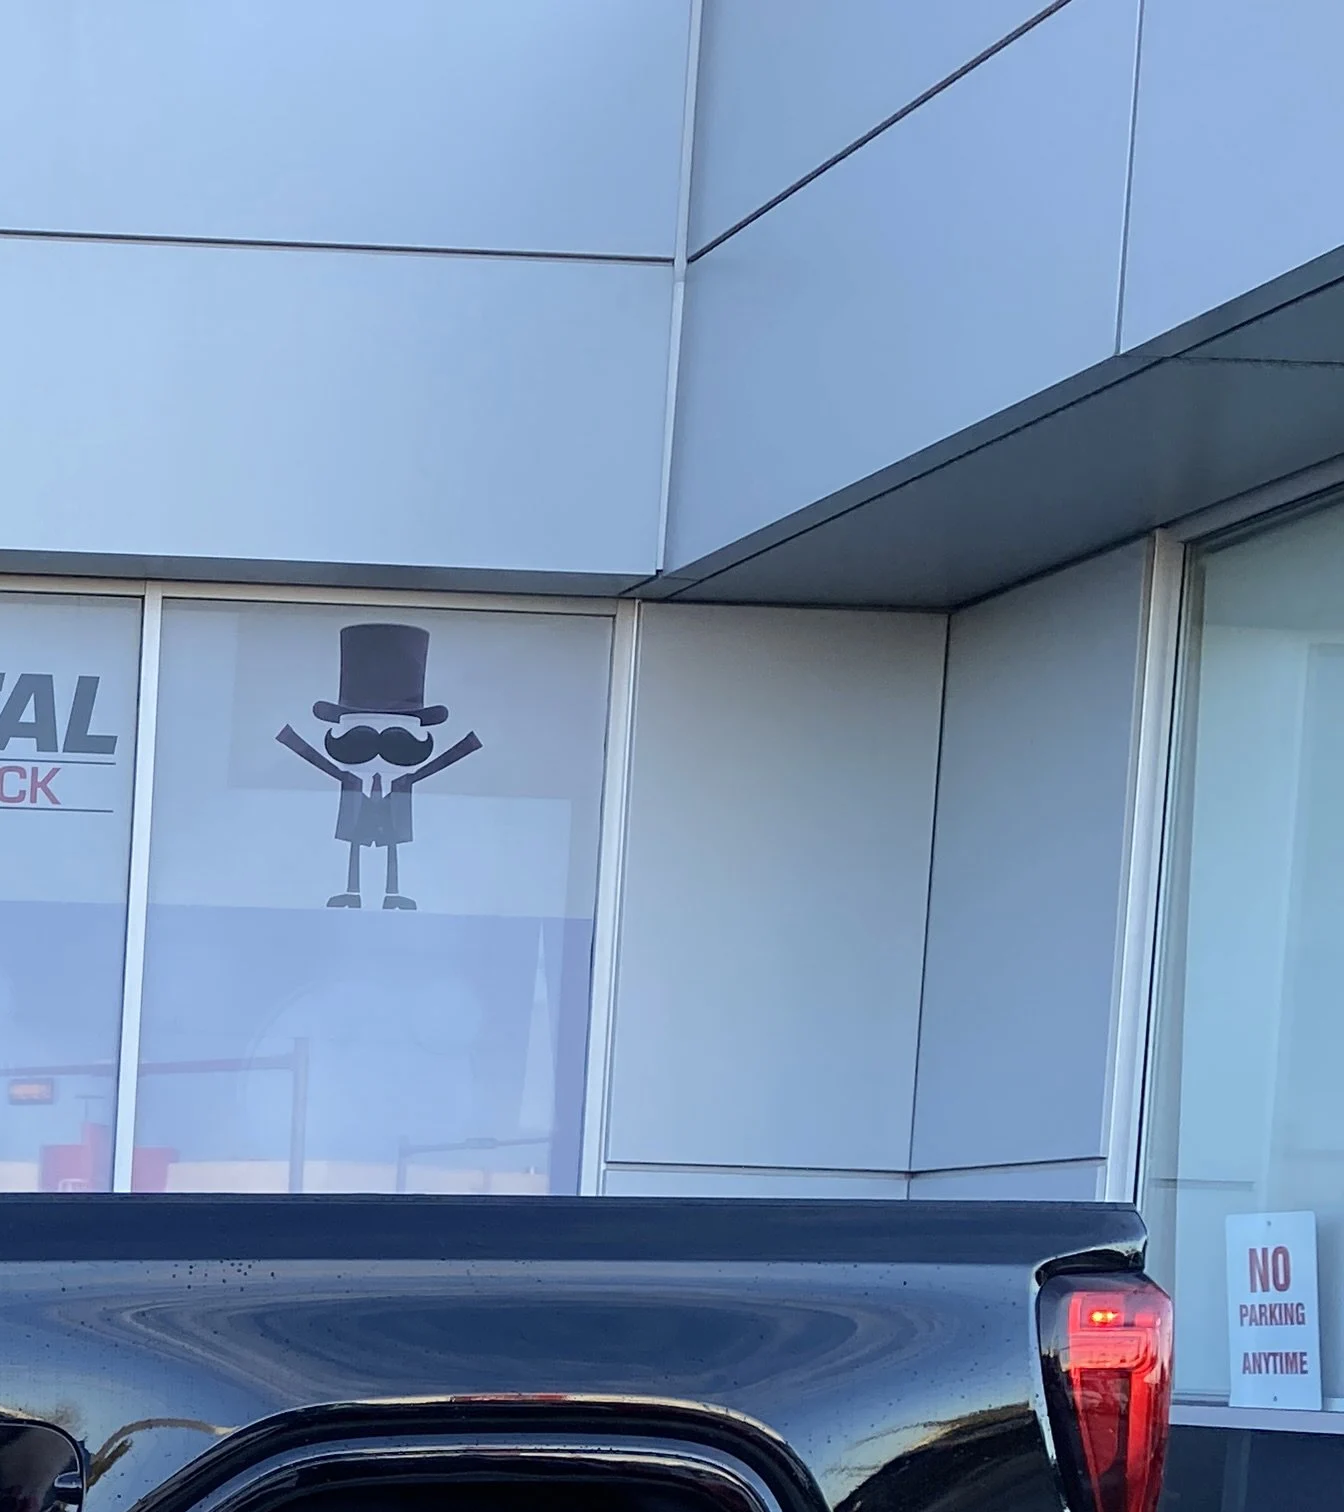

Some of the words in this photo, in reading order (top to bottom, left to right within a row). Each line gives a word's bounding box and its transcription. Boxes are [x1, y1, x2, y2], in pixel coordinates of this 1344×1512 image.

[1248, 1246, 1291, 1293] NO
[1239, 1302, 1306, 1327] PARKING
[1242, 1352, 1309, 1375] ANYTIME
